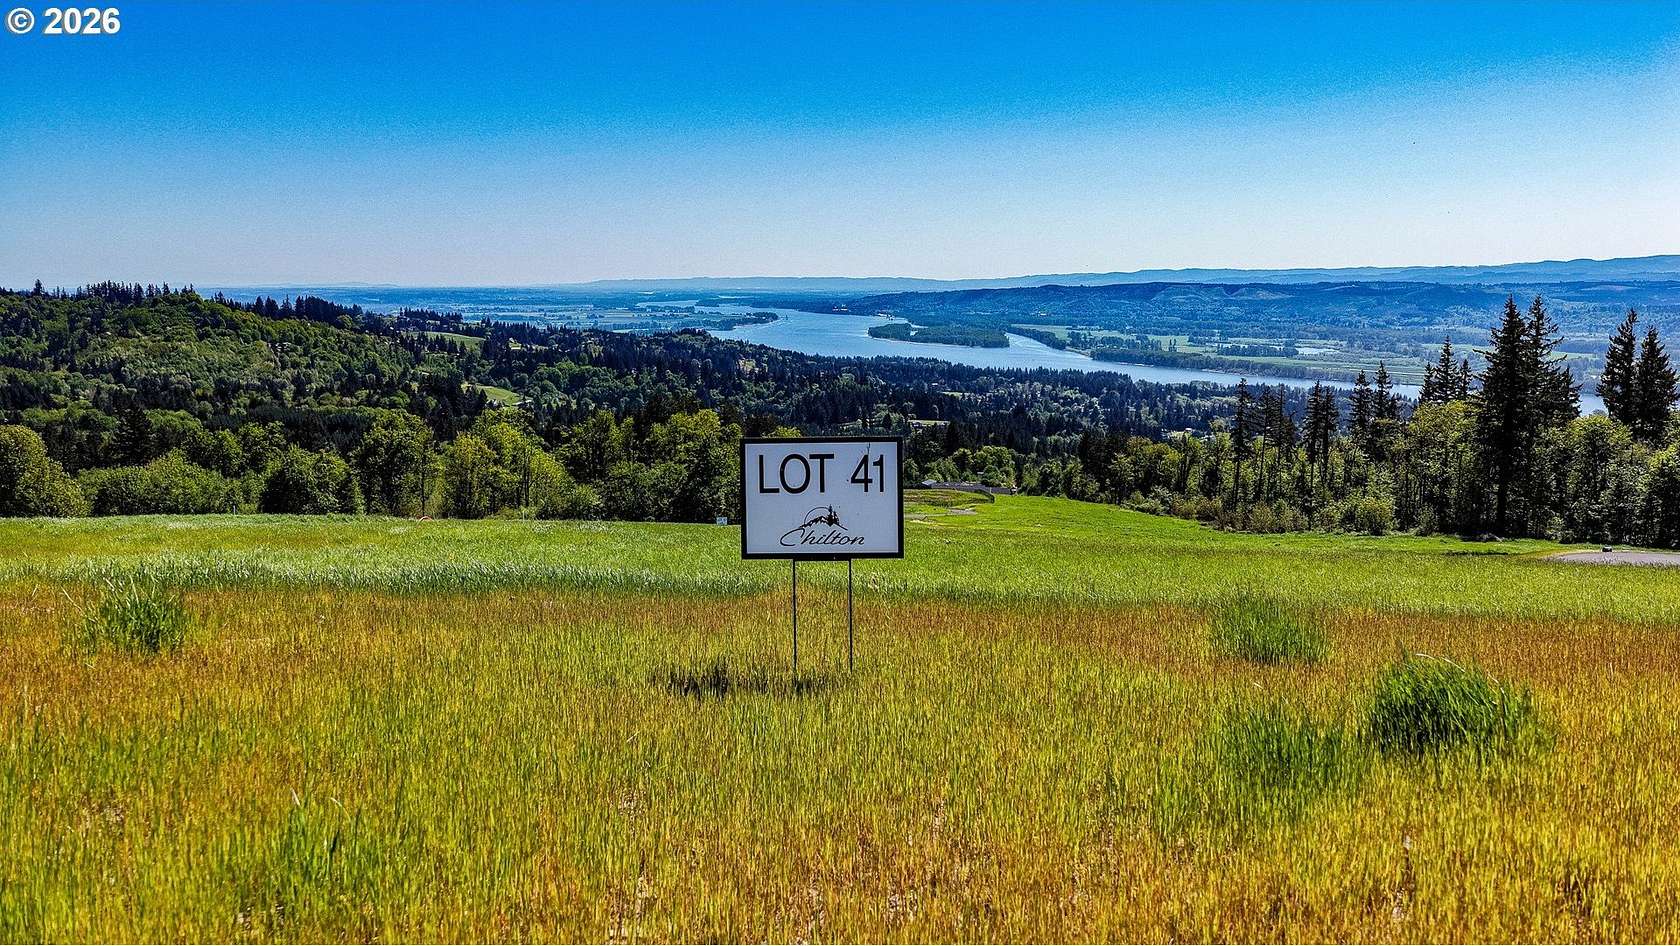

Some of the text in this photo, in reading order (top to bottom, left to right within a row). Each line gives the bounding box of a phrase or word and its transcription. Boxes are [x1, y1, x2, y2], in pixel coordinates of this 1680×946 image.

[758, 453, 885, 494] LOT 41
[779, 527, 865, 547] Chilton
